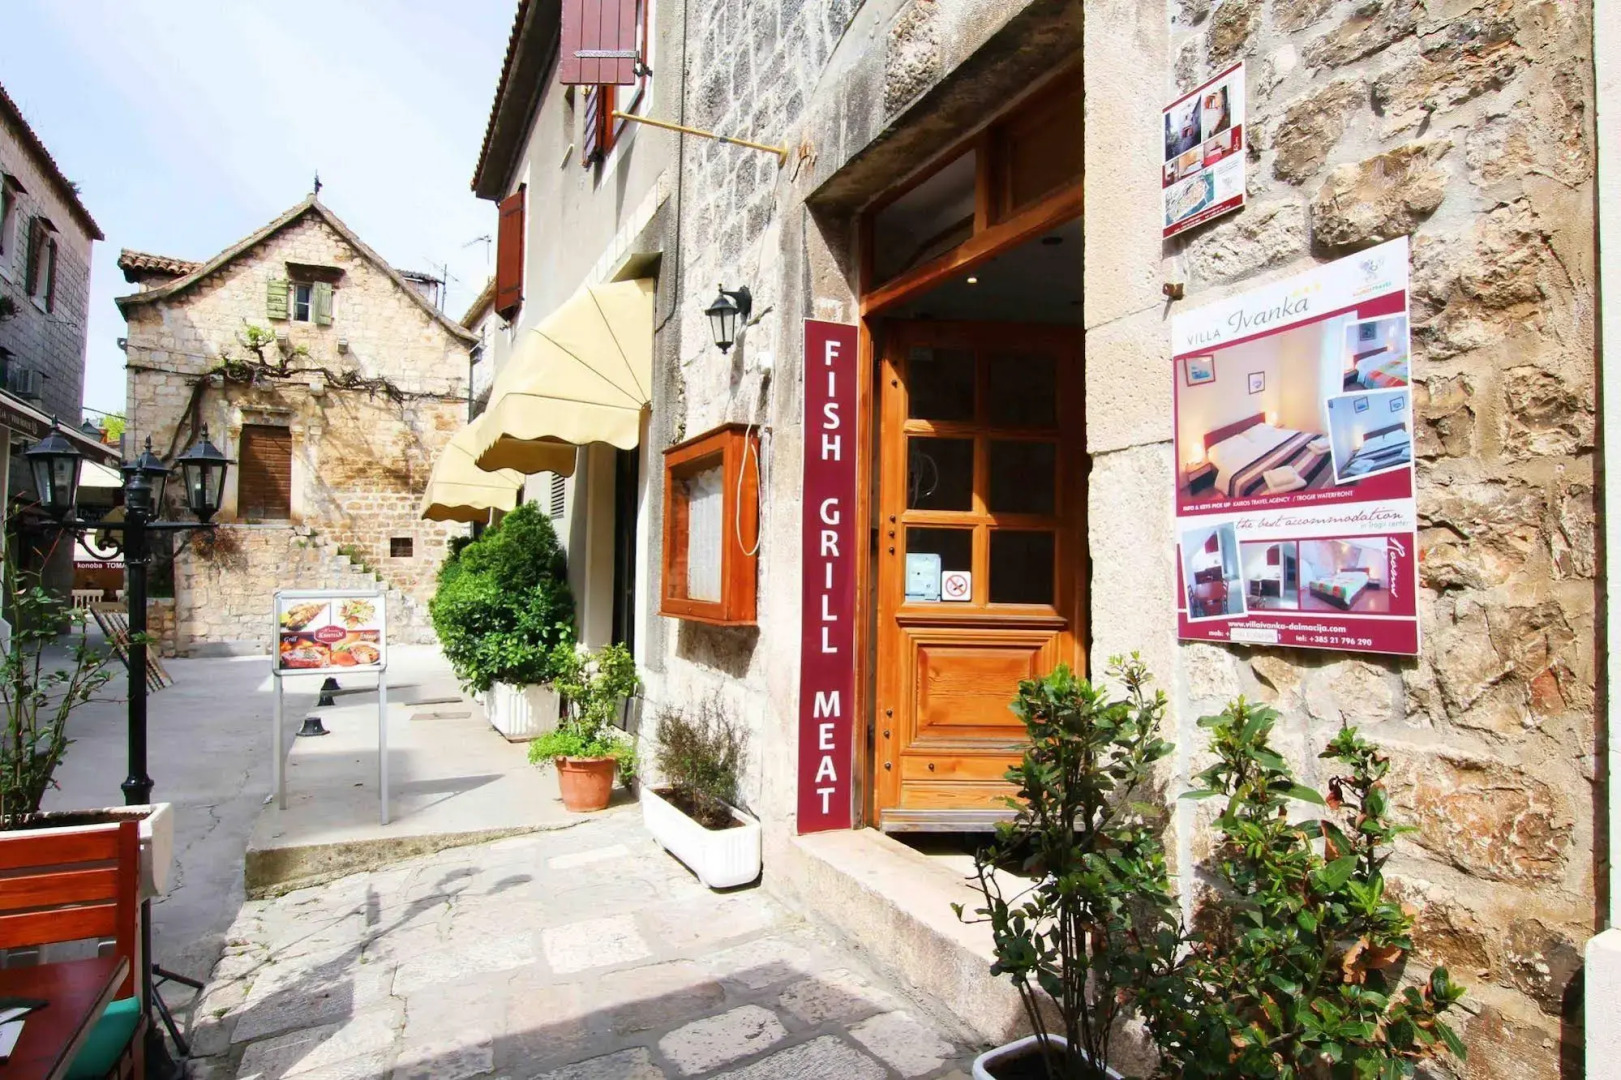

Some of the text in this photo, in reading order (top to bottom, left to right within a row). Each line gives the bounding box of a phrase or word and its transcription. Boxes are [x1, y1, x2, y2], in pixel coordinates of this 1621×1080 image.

[1186, 295, 1310, 345] VILLA Ivanka
[1251, 498, 1268, 506] TRAVEL
[1268, 496, 1290, 504] AGENCY
[1296, 493, 1316, 502] TROGIR
[1316, 490, 1354, 500] WATERFRONT
[1235, 517, 1254, 530] the
[1257, 514, 1285, 528] best
[812, 339, 842, 815] FISH GRILL MEAT
[1227, 620, 1347, 634] www.villaivanka-dalmacija.com
[1295, 634, 1373, 647] tel: +385 21 796 290
